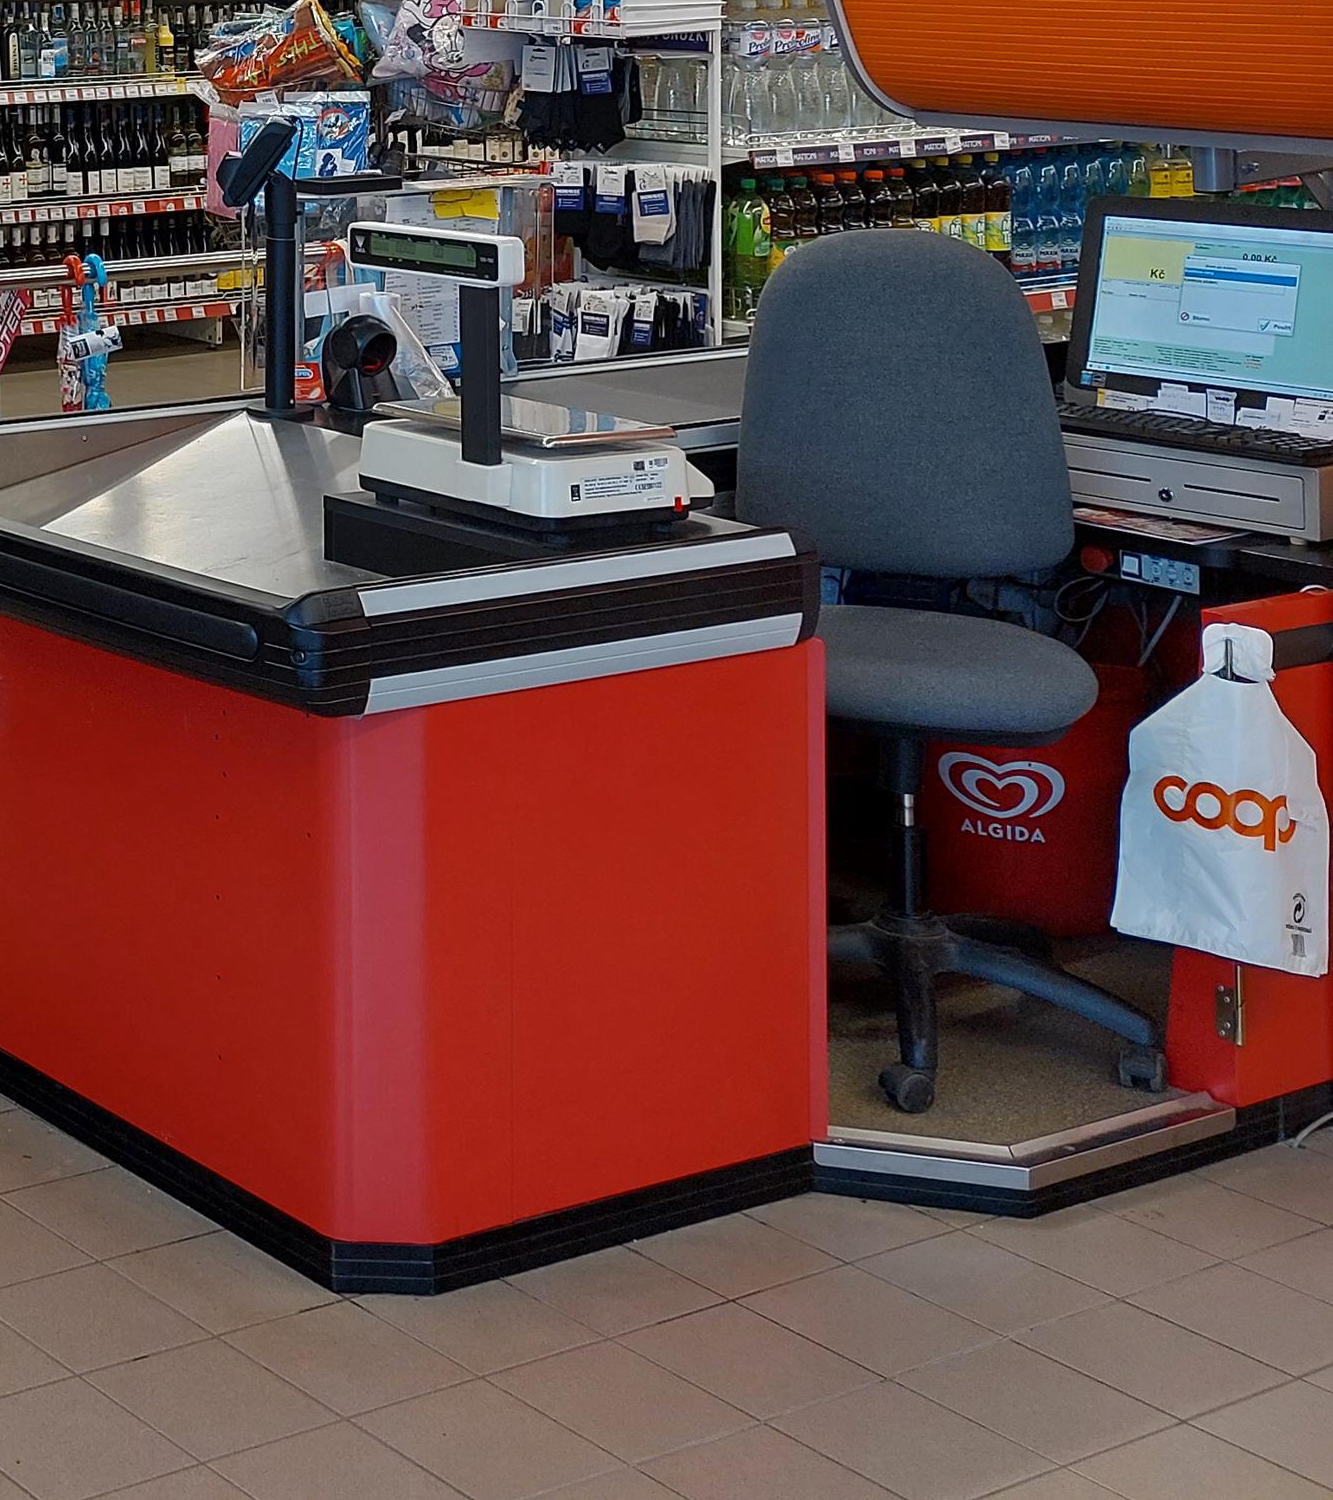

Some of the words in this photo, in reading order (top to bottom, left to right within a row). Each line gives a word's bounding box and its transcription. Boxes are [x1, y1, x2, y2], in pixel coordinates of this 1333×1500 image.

[1149, 268, 1165, 279] Kč
[1153, 775, 1296, 852] coop
[960, 818, 1046, 844] ALGIDA
